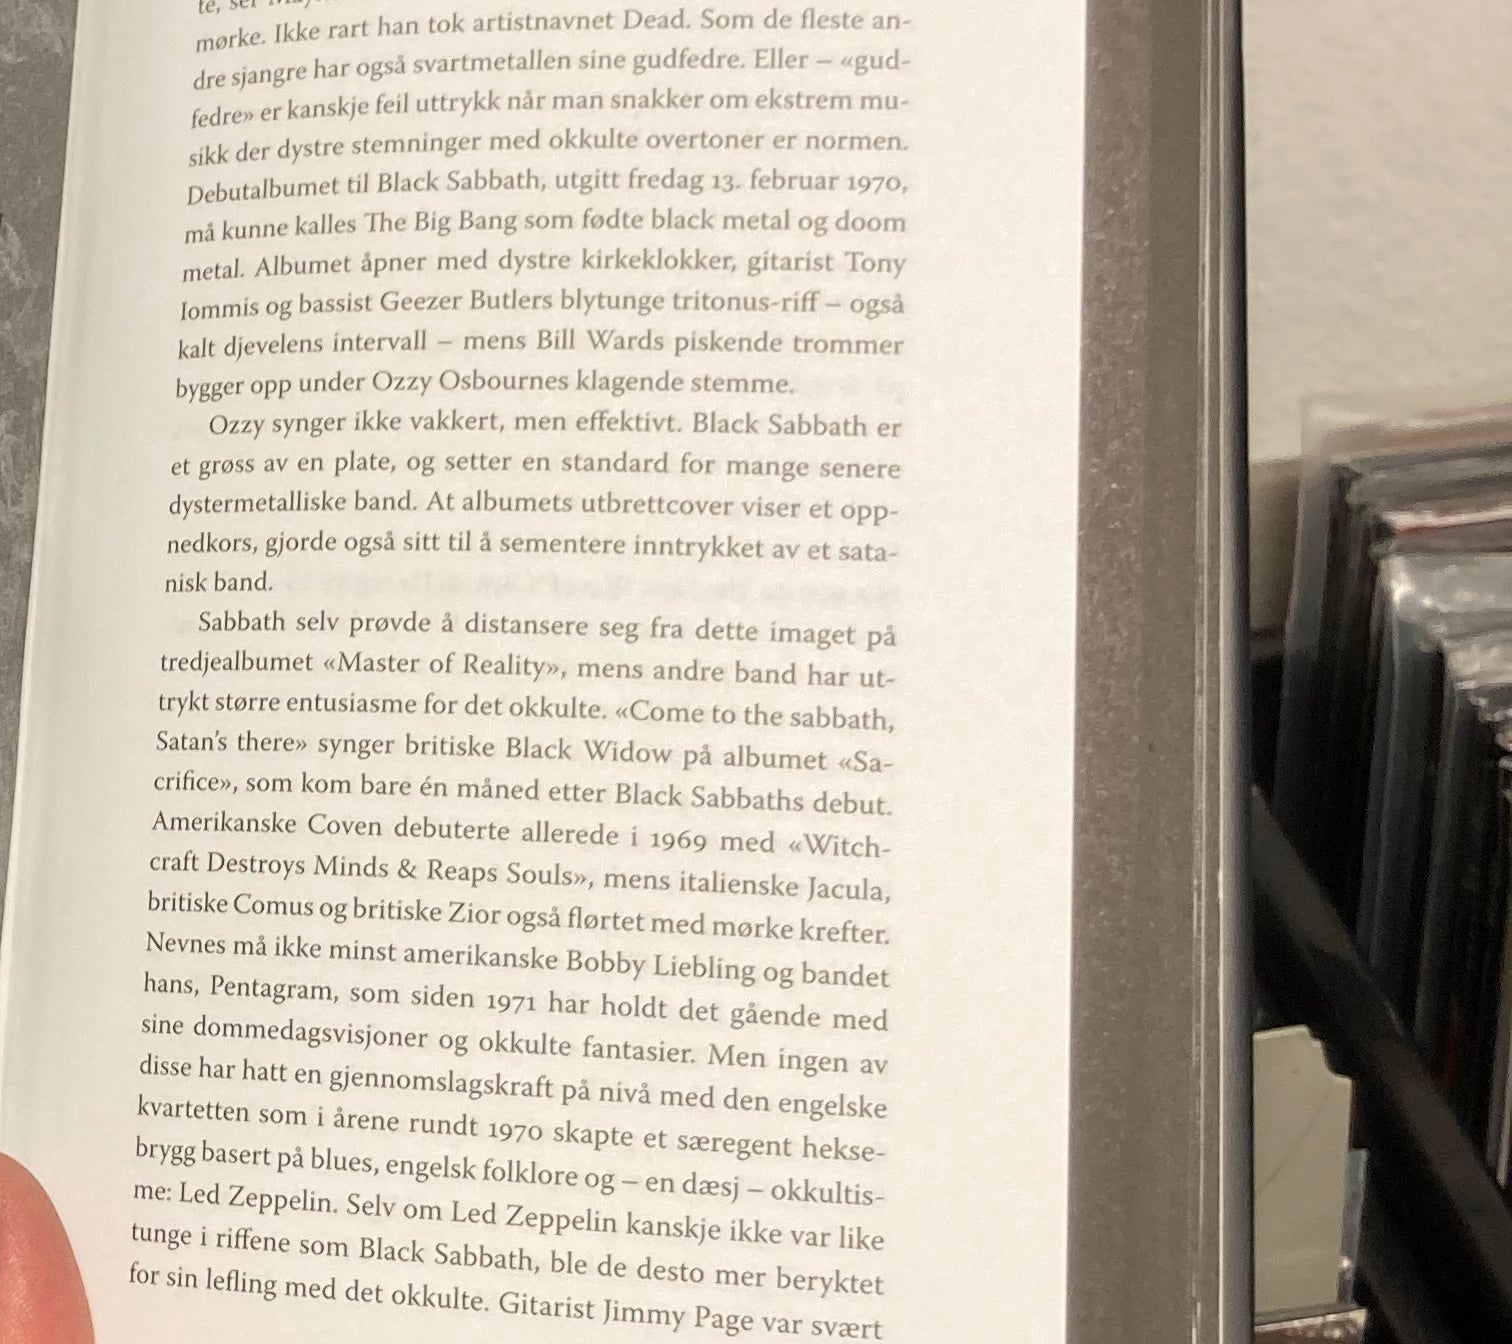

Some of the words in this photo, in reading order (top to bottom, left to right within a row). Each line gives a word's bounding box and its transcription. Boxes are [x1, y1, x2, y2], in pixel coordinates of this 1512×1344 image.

[186, 177, 340, 206] Debutalbumet
[347, 172, 369, 195] til
[377, 169, 439, 193] Black
[446, 167, 547, 193] Sabbath,
[555, 168, 620, 196] utgitt
[628, 166, 705, 196] fredag
[712, 174, 741, 193] 13.
[750, 167, 840, 191] februar
[847, 175, 908, 195] 1970,
[168, 489, 347, 521] dystermetalliske
[354, 488, 418, 511] band.
[425, 490, 455, 512] At
[461, 488, 573, 513] albumets
[581, 490, 735, 516] utbrettcover
[741, 496, 802, 518] viser
[808, 500, 833, 519] et
[840, 504, 899, 527] opp-
[151, 809, 297, 834] Amerikanske
[307, 812, 383, 837] Coven
[393, 814, 511, 842] debuterte
[521, 819, 620, 847] allerede
[630, 825, 638, 848] i
[651, 829, 708, 854] 1969
[719, 830, 776, 854] med
[129, 1260, 161, 1286] for
[166, 1266, 198, 1289] sin
[205, 1266, 278, 1303] lefling
[284, 1276, 337, 1301] med
[344, 1278, 384, 1305] det
[391, 1282, 489, 1312] okkulte.
[498, 1291, 595, 1321] Gitarist
[602, 1298, 687, 1333] Jimmy
[694, 1305, 755, 1338] Page
[761, 1316, 804, 1335] var
[811, 1320, 883, 1341] svært
